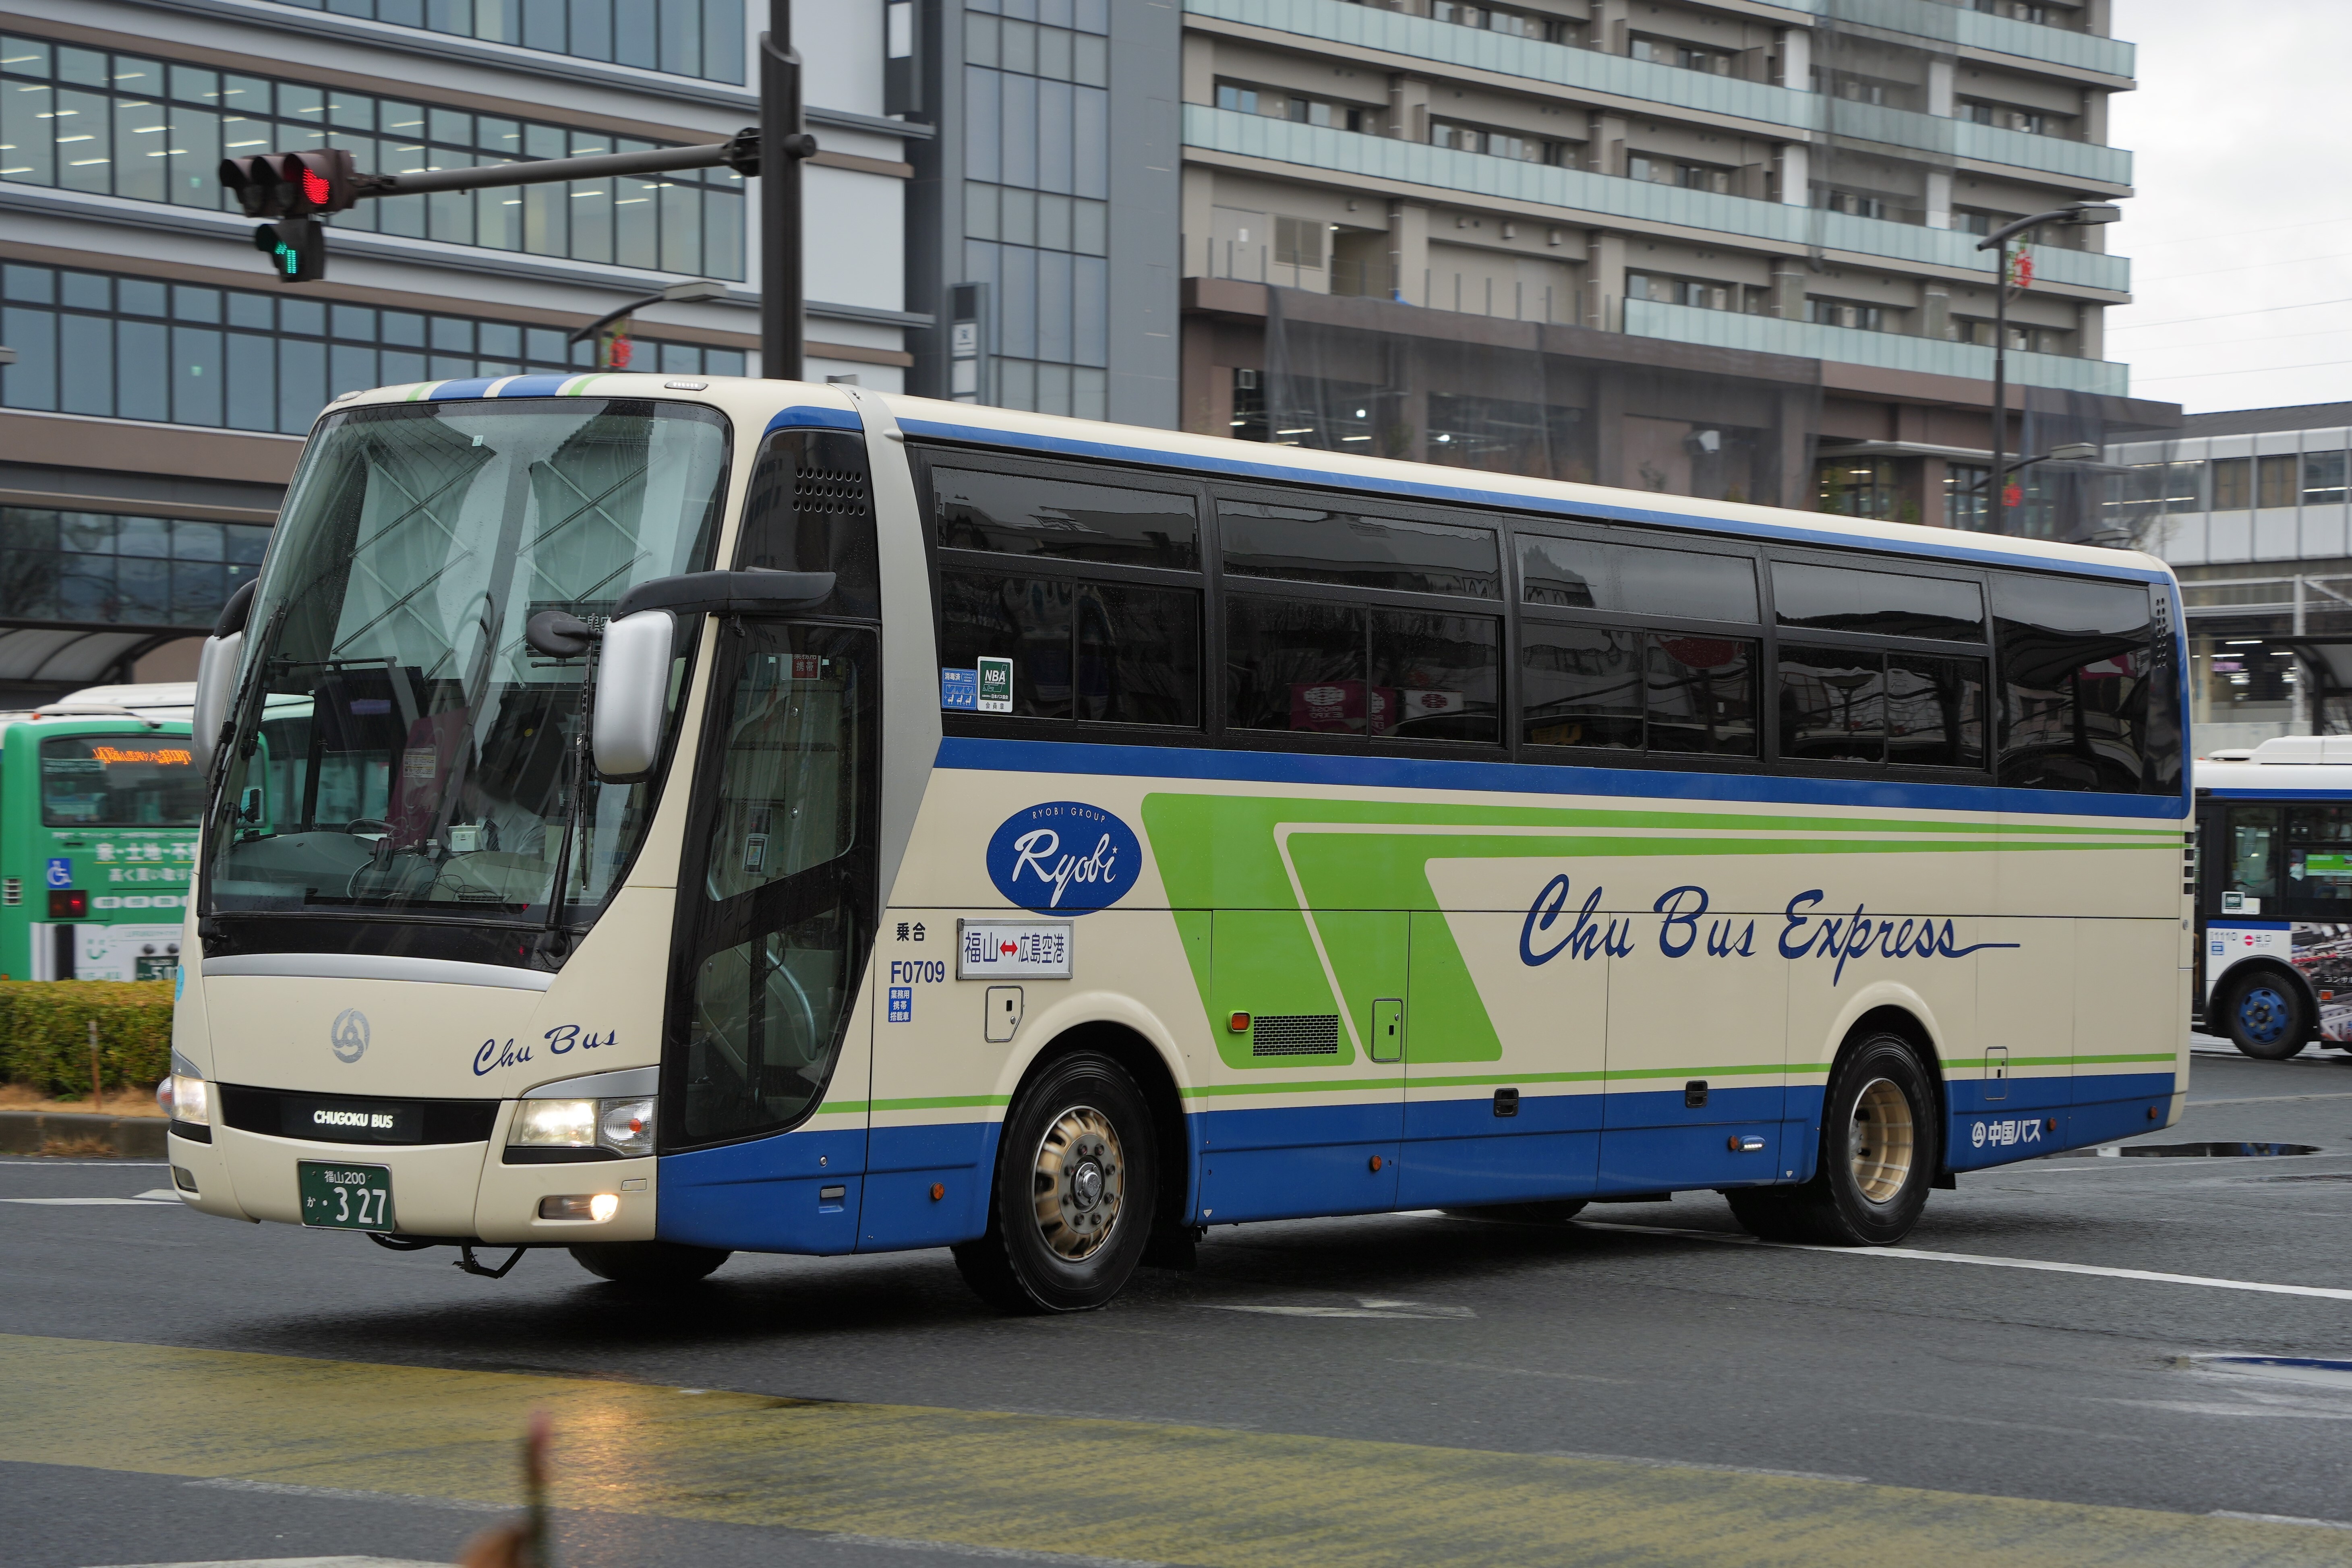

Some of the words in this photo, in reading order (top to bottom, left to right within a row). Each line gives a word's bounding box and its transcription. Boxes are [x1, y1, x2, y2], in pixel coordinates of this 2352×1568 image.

[985, 669, 1005, 682] NBA
[1032, 807, 1063, 819] RYOBI
[1071, 807, 1106, 823] GROUP
[1012, 829, 1117, 908] Ryobi
[896, 922, 926, 942] 乗合
[1519, 874, 1635, 966] Chu
[1653, 885, 1757, 958] Bus
[1778, 889, 2021, 987] Express
[2255, 934, 2272, 942] 出口
[965, 931, 998, 964] 福山
[1018, 932, 1064, 964] 広島空港
[890, 960, 945, 984] F0709
[890, 989, 910, 999] 業務用
[893, 1000, 907, 1010] 携帯
[890, 1011, 909, 1021] 搭載車
[473, 1038, 534, 1076] Chu
[544, 1024, 619, 1054] Bus
[313, 1110, 369, 1127] CHUGOKU
[371, 1114, 393, 1129] BUS
[1988, 1119, 2041, 1147] 中国バス
[306, 1196, 316, 1208] か
